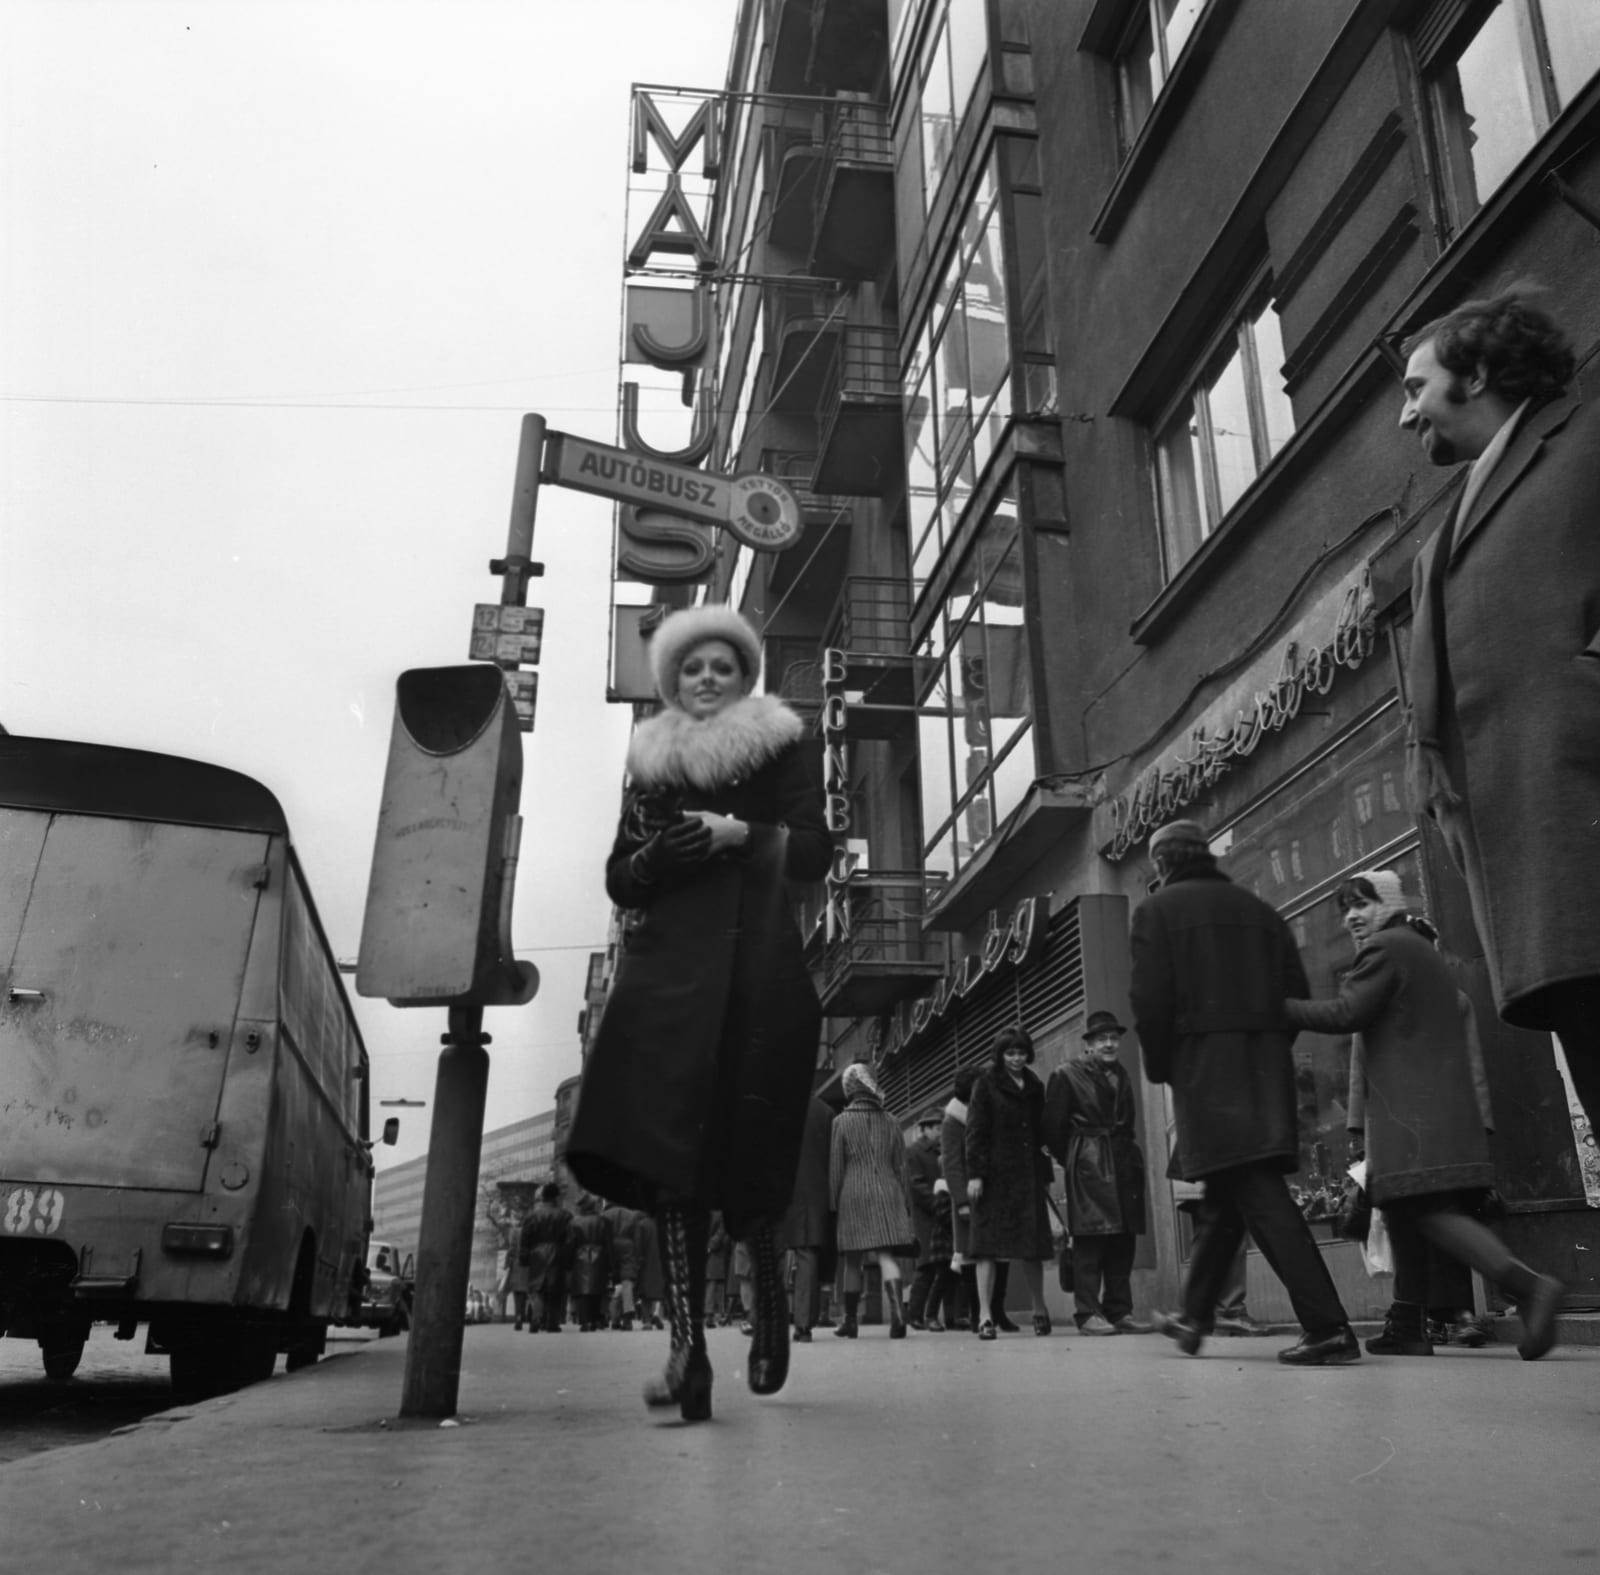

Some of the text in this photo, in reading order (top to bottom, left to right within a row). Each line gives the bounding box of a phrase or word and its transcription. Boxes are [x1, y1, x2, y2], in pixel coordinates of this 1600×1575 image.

[579, 452, 716, 508] AUTÓBUSZ
[478, 609, 496, 627] 12
[823, 648, 850, 944] BONBON
[4, 1187, 64, 1235] 89
